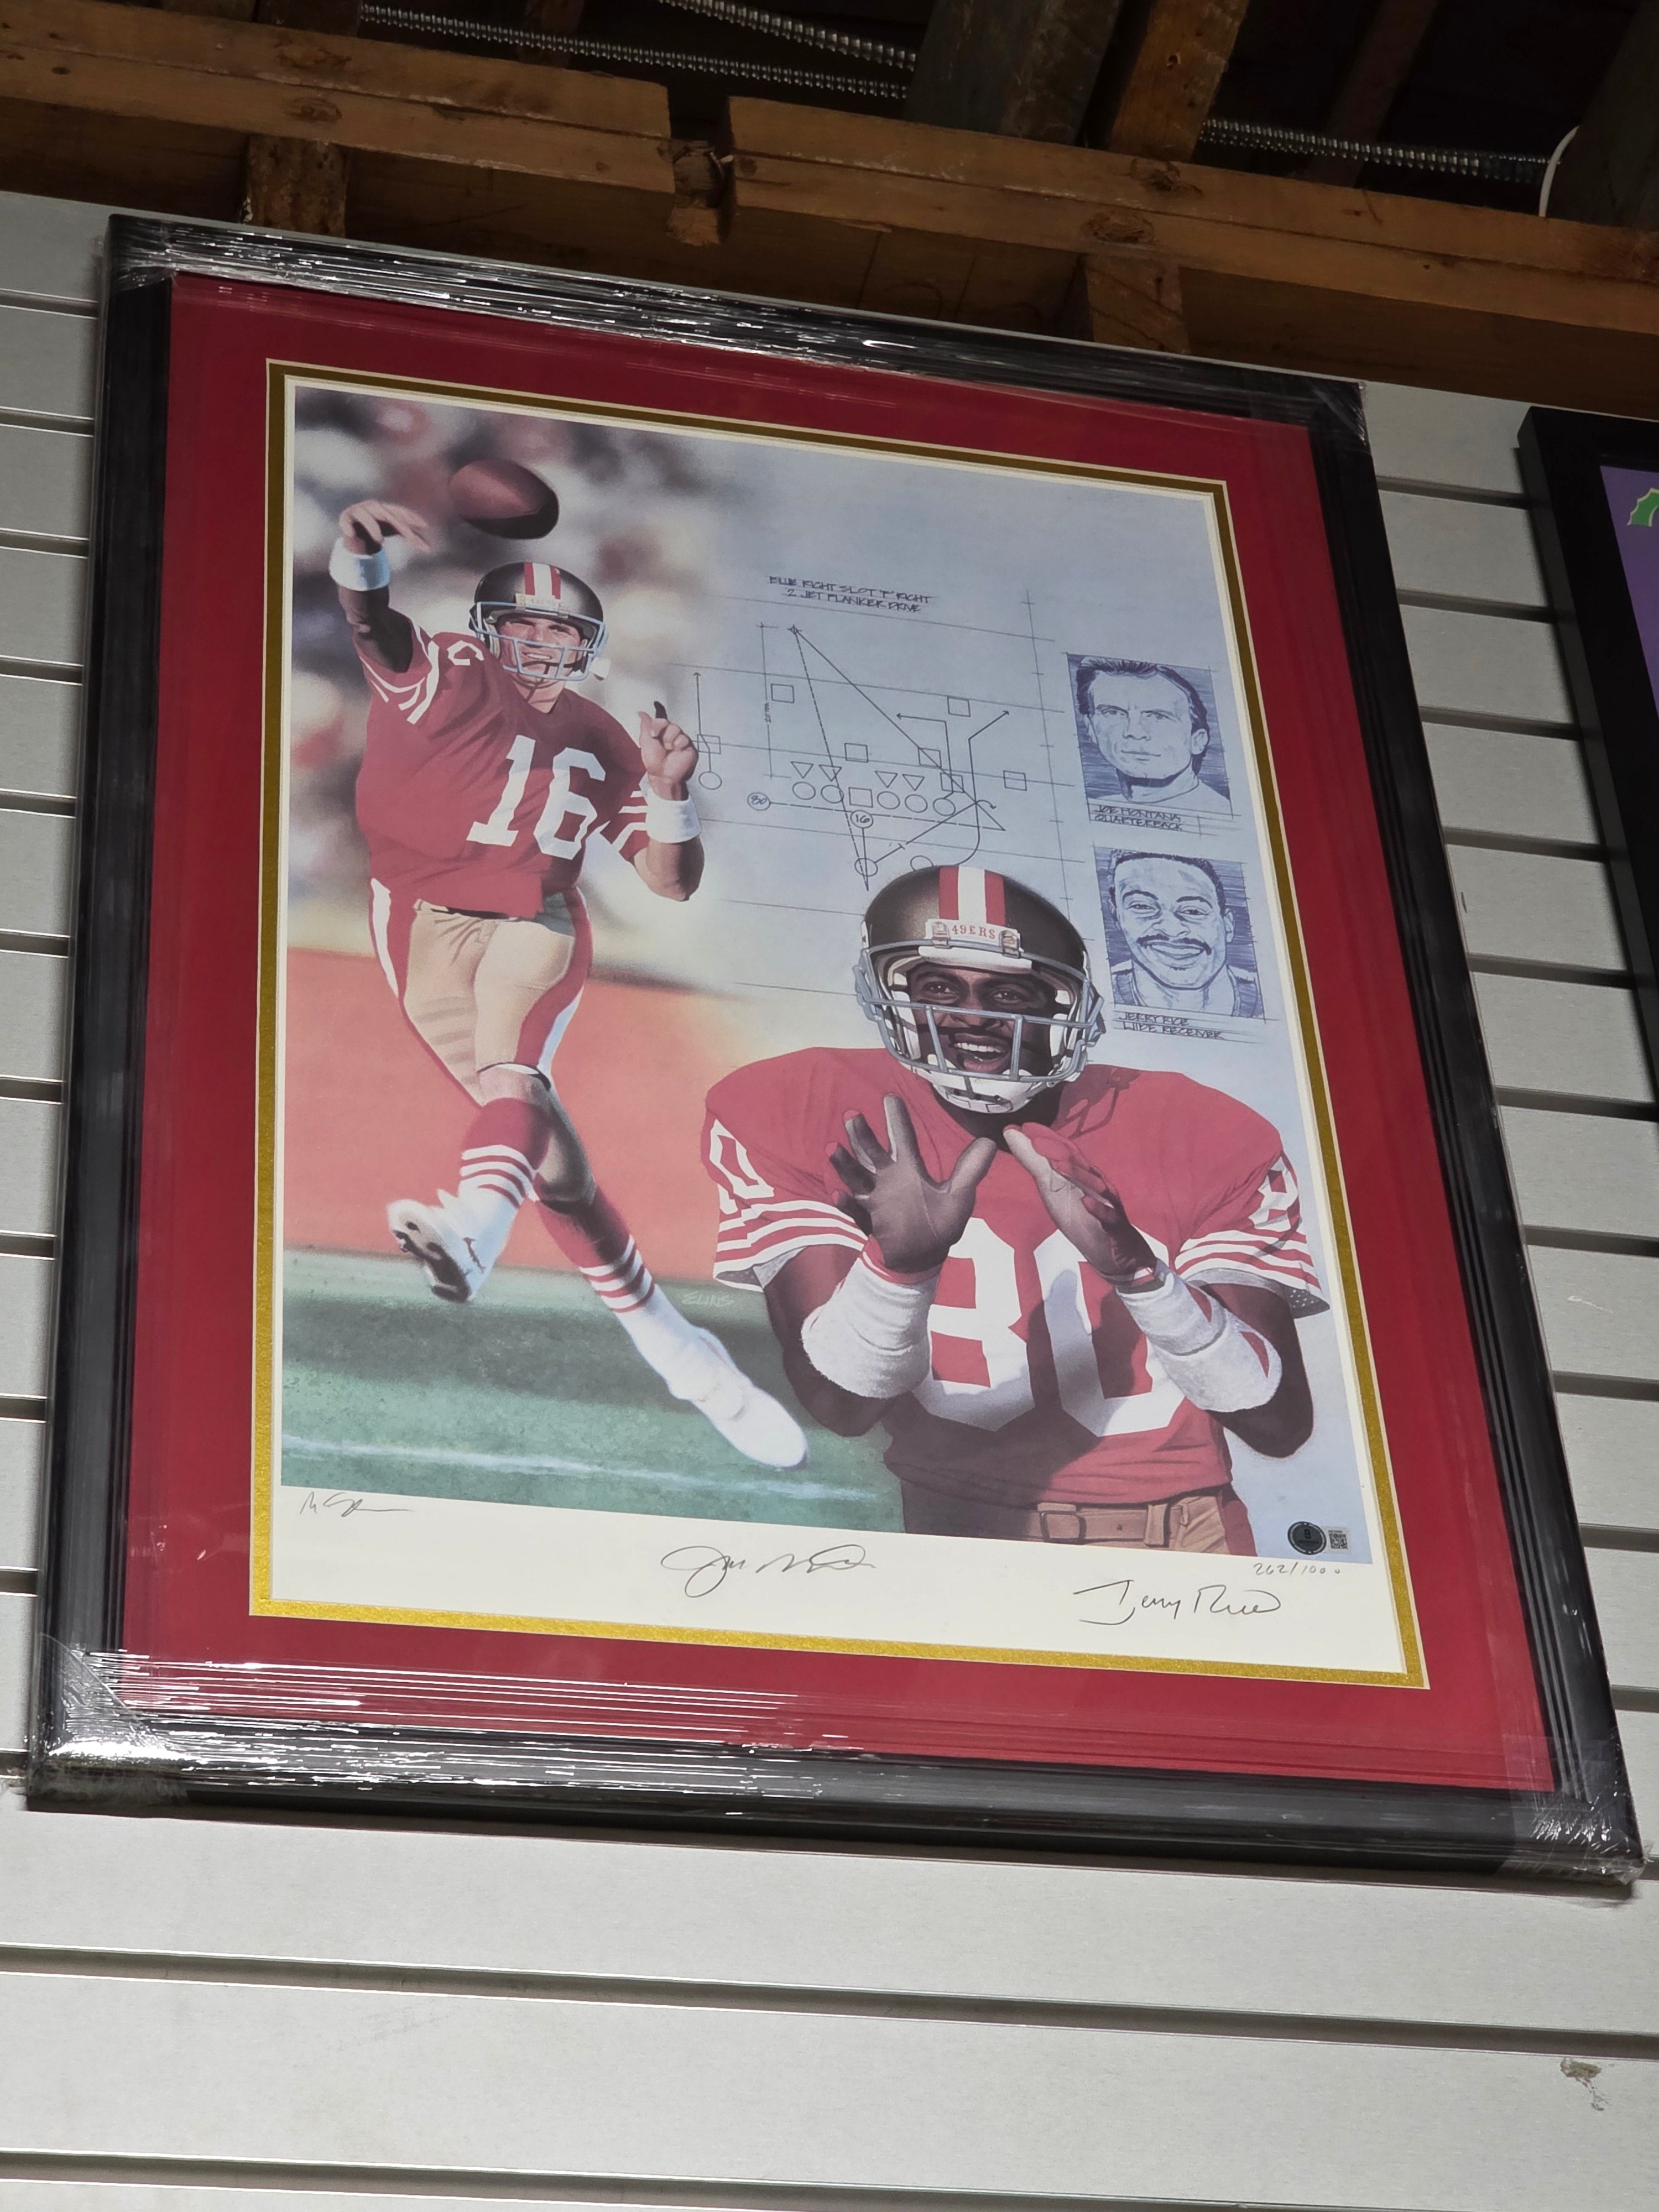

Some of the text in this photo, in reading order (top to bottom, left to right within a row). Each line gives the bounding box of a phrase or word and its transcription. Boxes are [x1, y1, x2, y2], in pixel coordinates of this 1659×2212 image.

[787, 588, 921, 613] 2 JET FLANKER DRIVE
[802, 580, 837, 591] RIGHT
[839, 585, 876, 597] SLOT
[896, 592, 932, 603] RIGHT
[466, 735, 606, 860] 16
[855, 815, 870, 823] 16
[1094, 814, 1183, 831] QUARTERBACK
[1095, 805, 1181, 823] JOE MONTANA
[952, 925, 995, 939] 49ERS
[1119, 1012, 1188, 1026] JERRY RICE
[1123, 1022, 1222, 1040] WIDE RECEIVER
